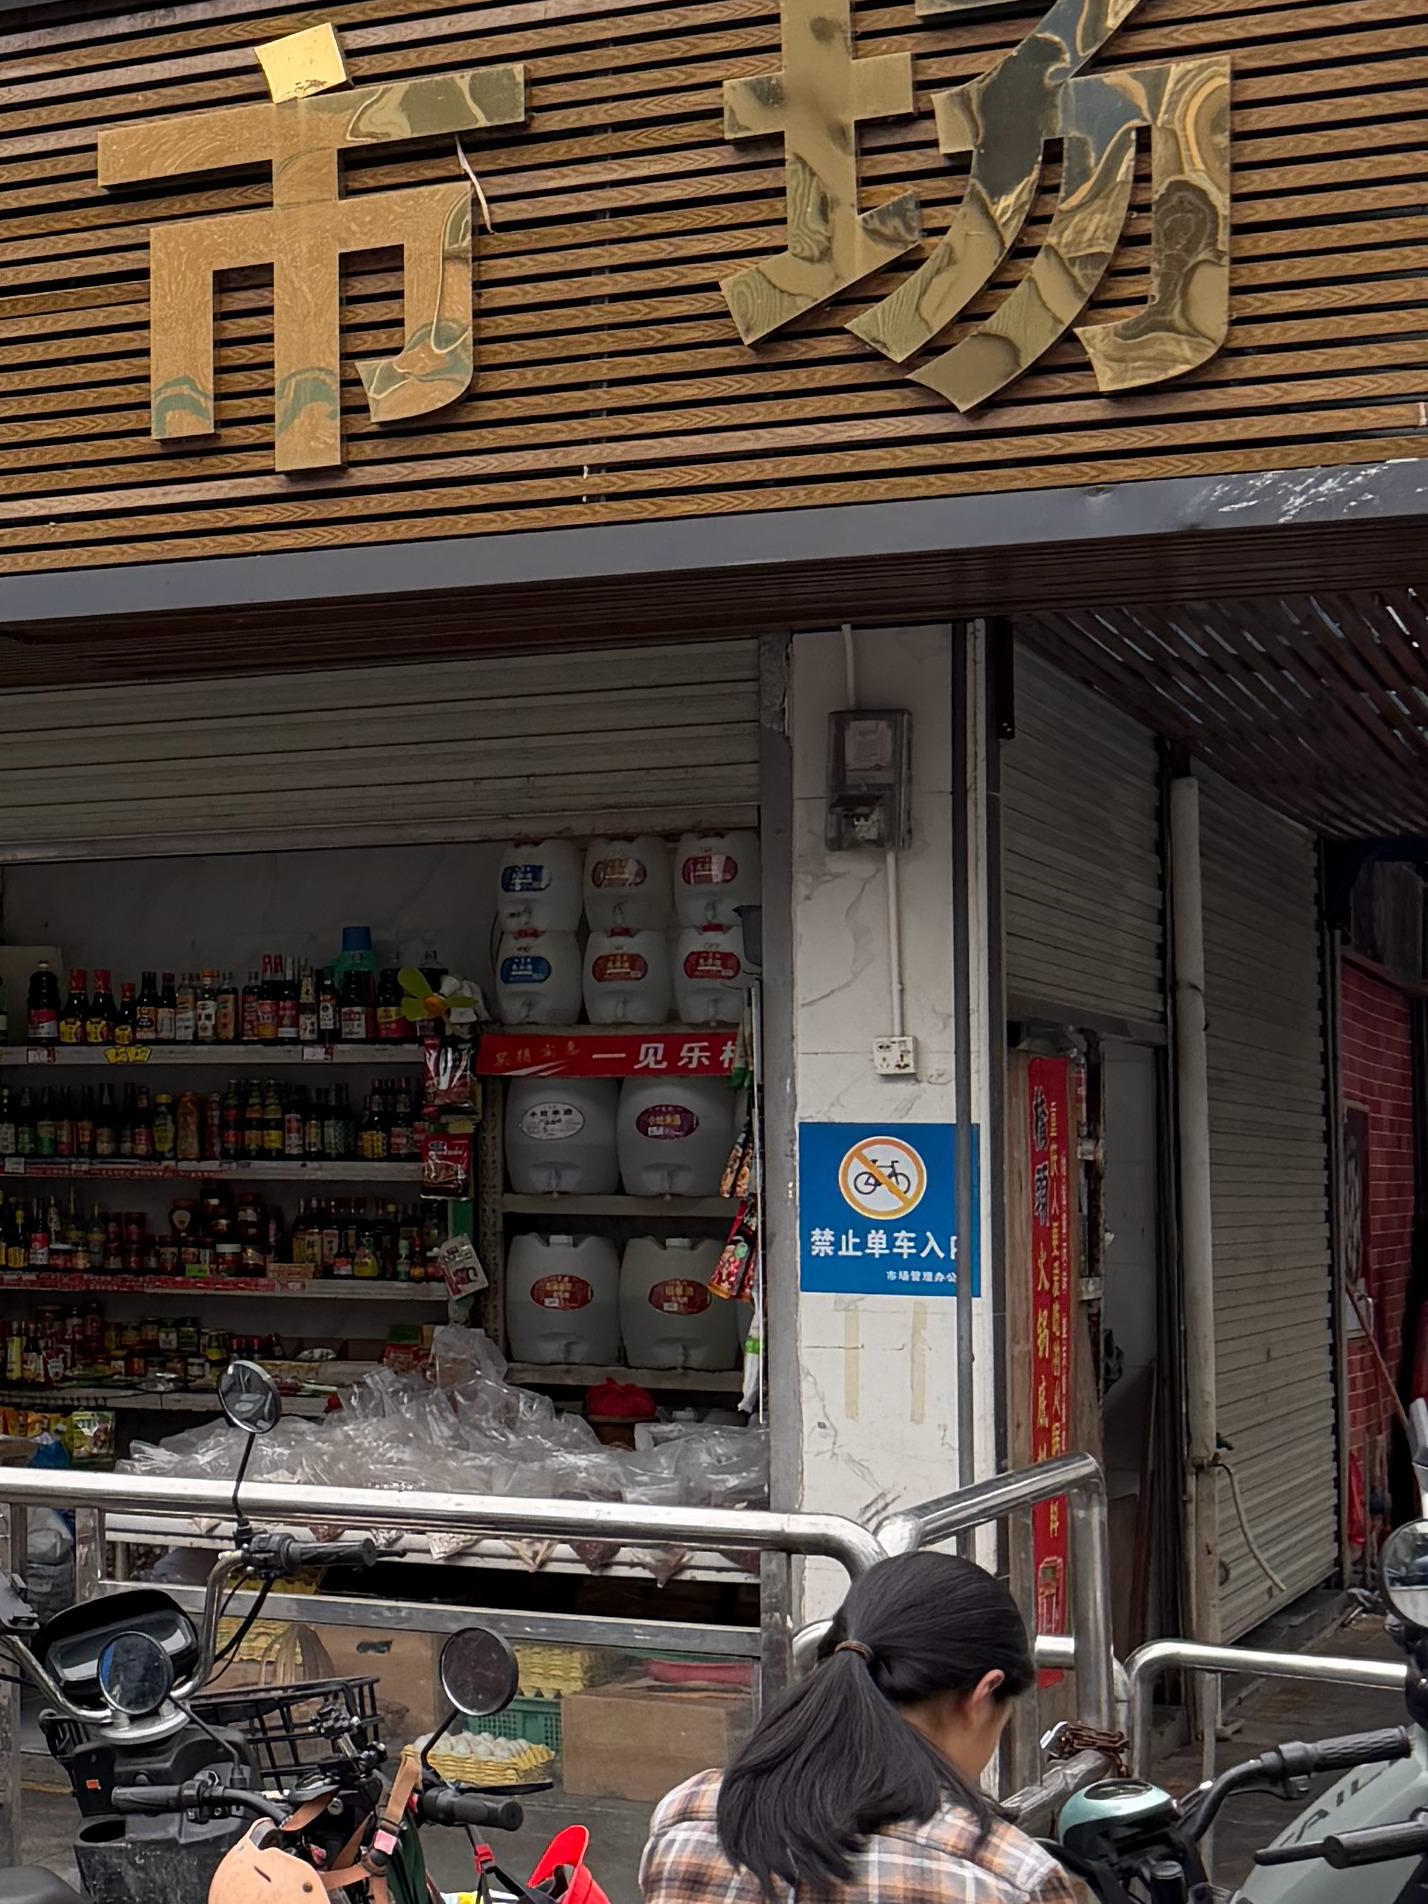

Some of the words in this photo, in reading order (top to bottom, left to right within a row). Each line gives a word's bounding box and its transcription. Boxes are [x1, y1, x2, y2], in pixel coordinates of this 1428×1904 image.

[886, 1270, 958, 1283] 市场管理办公
